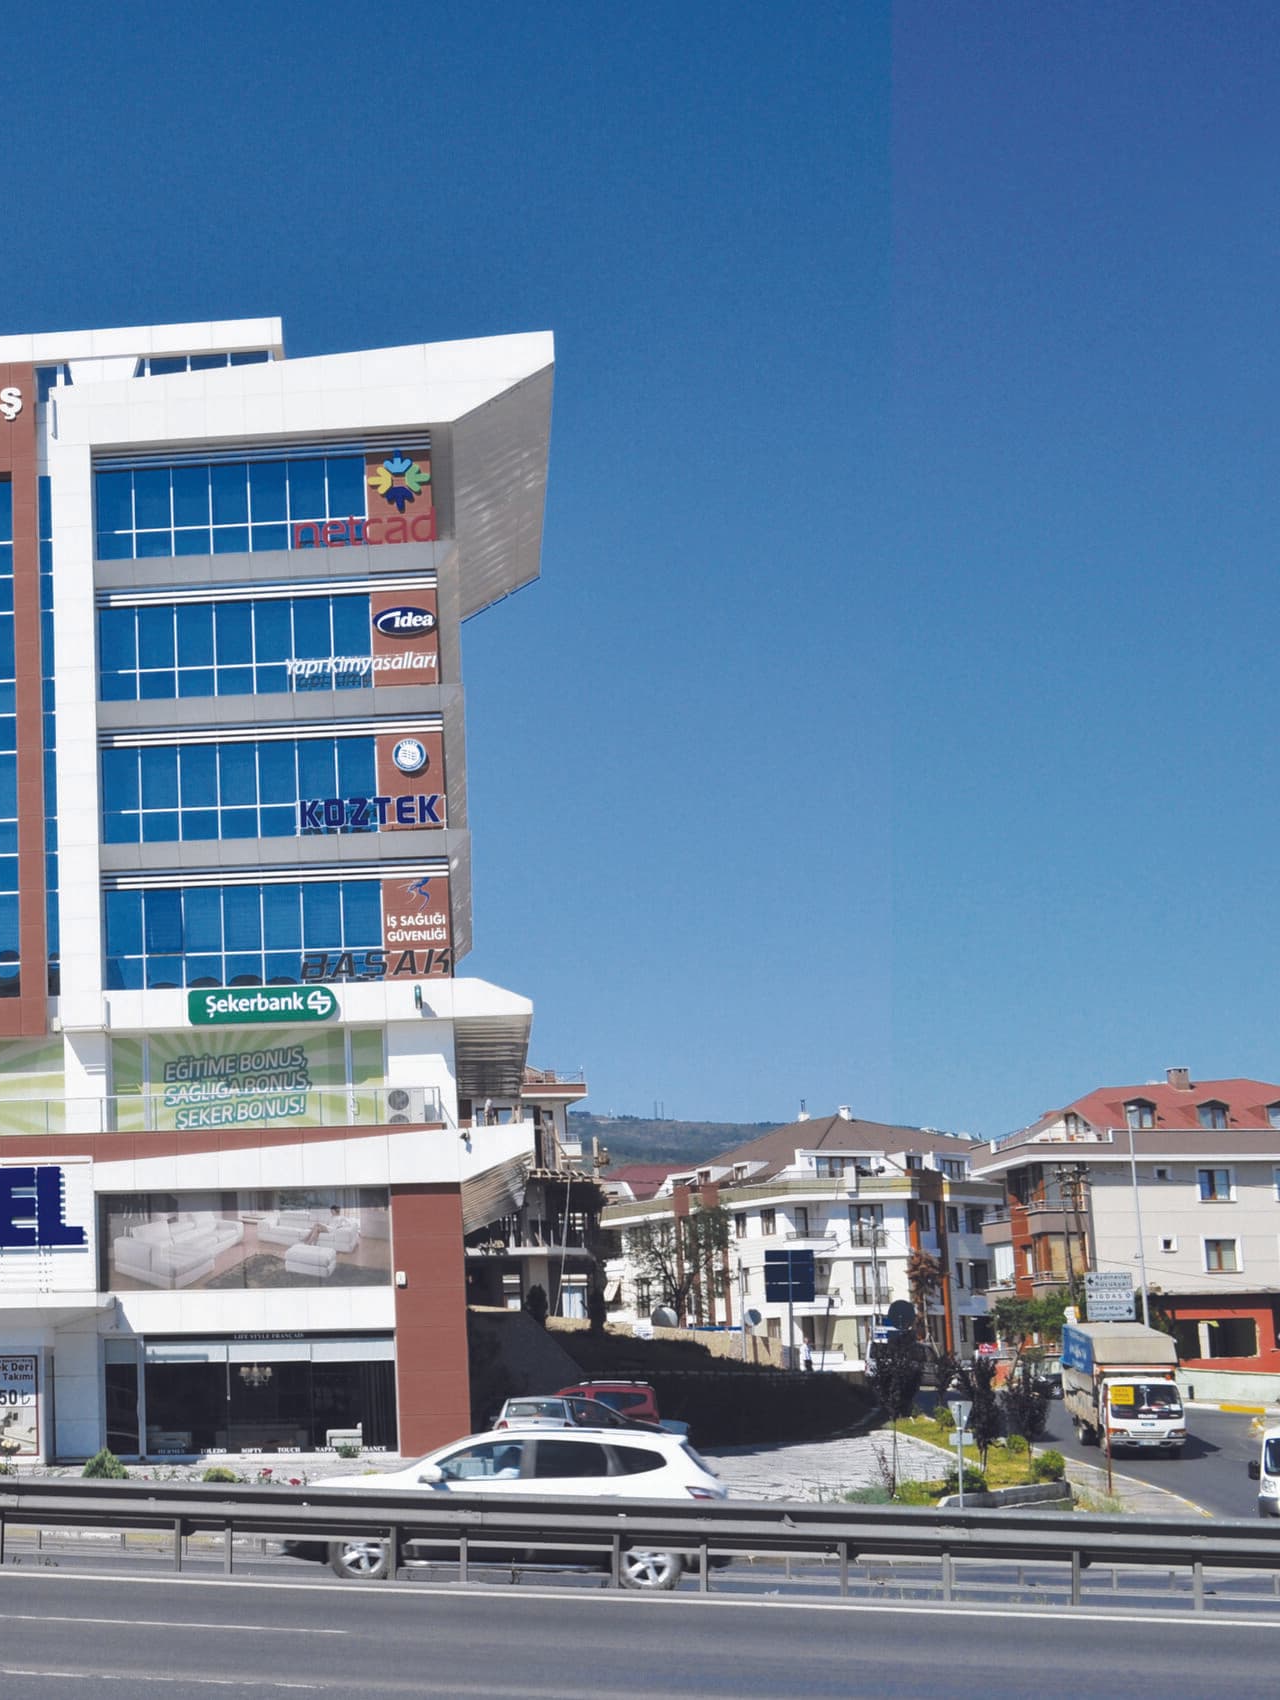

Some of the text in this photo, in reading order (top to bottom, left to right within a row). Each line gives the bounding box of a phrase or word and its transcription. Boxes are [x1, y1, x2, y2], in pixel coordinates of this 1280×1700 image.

[294, 506, 437, 550] netcad
[390, 611, 435, 629] idea
[299, 794, 441, 829] KOZTEK
[386, 912, 446, 928] İŞ SAĞLIĞI
[386, 927, 447, 942] GÜVENLİĞİ
[205, 988, 305, 1019] Şekerbank
[165, 1045, 308, 1083] EĞİTİME BONUS,
[244, 1071, 312, 1094] BONUS,
[176, 1097, 306, 1130] ŞEKER BONUS!
[2, 1373, 34, 1381] Takımı
[11, 1362, 33, 1372] Deri
